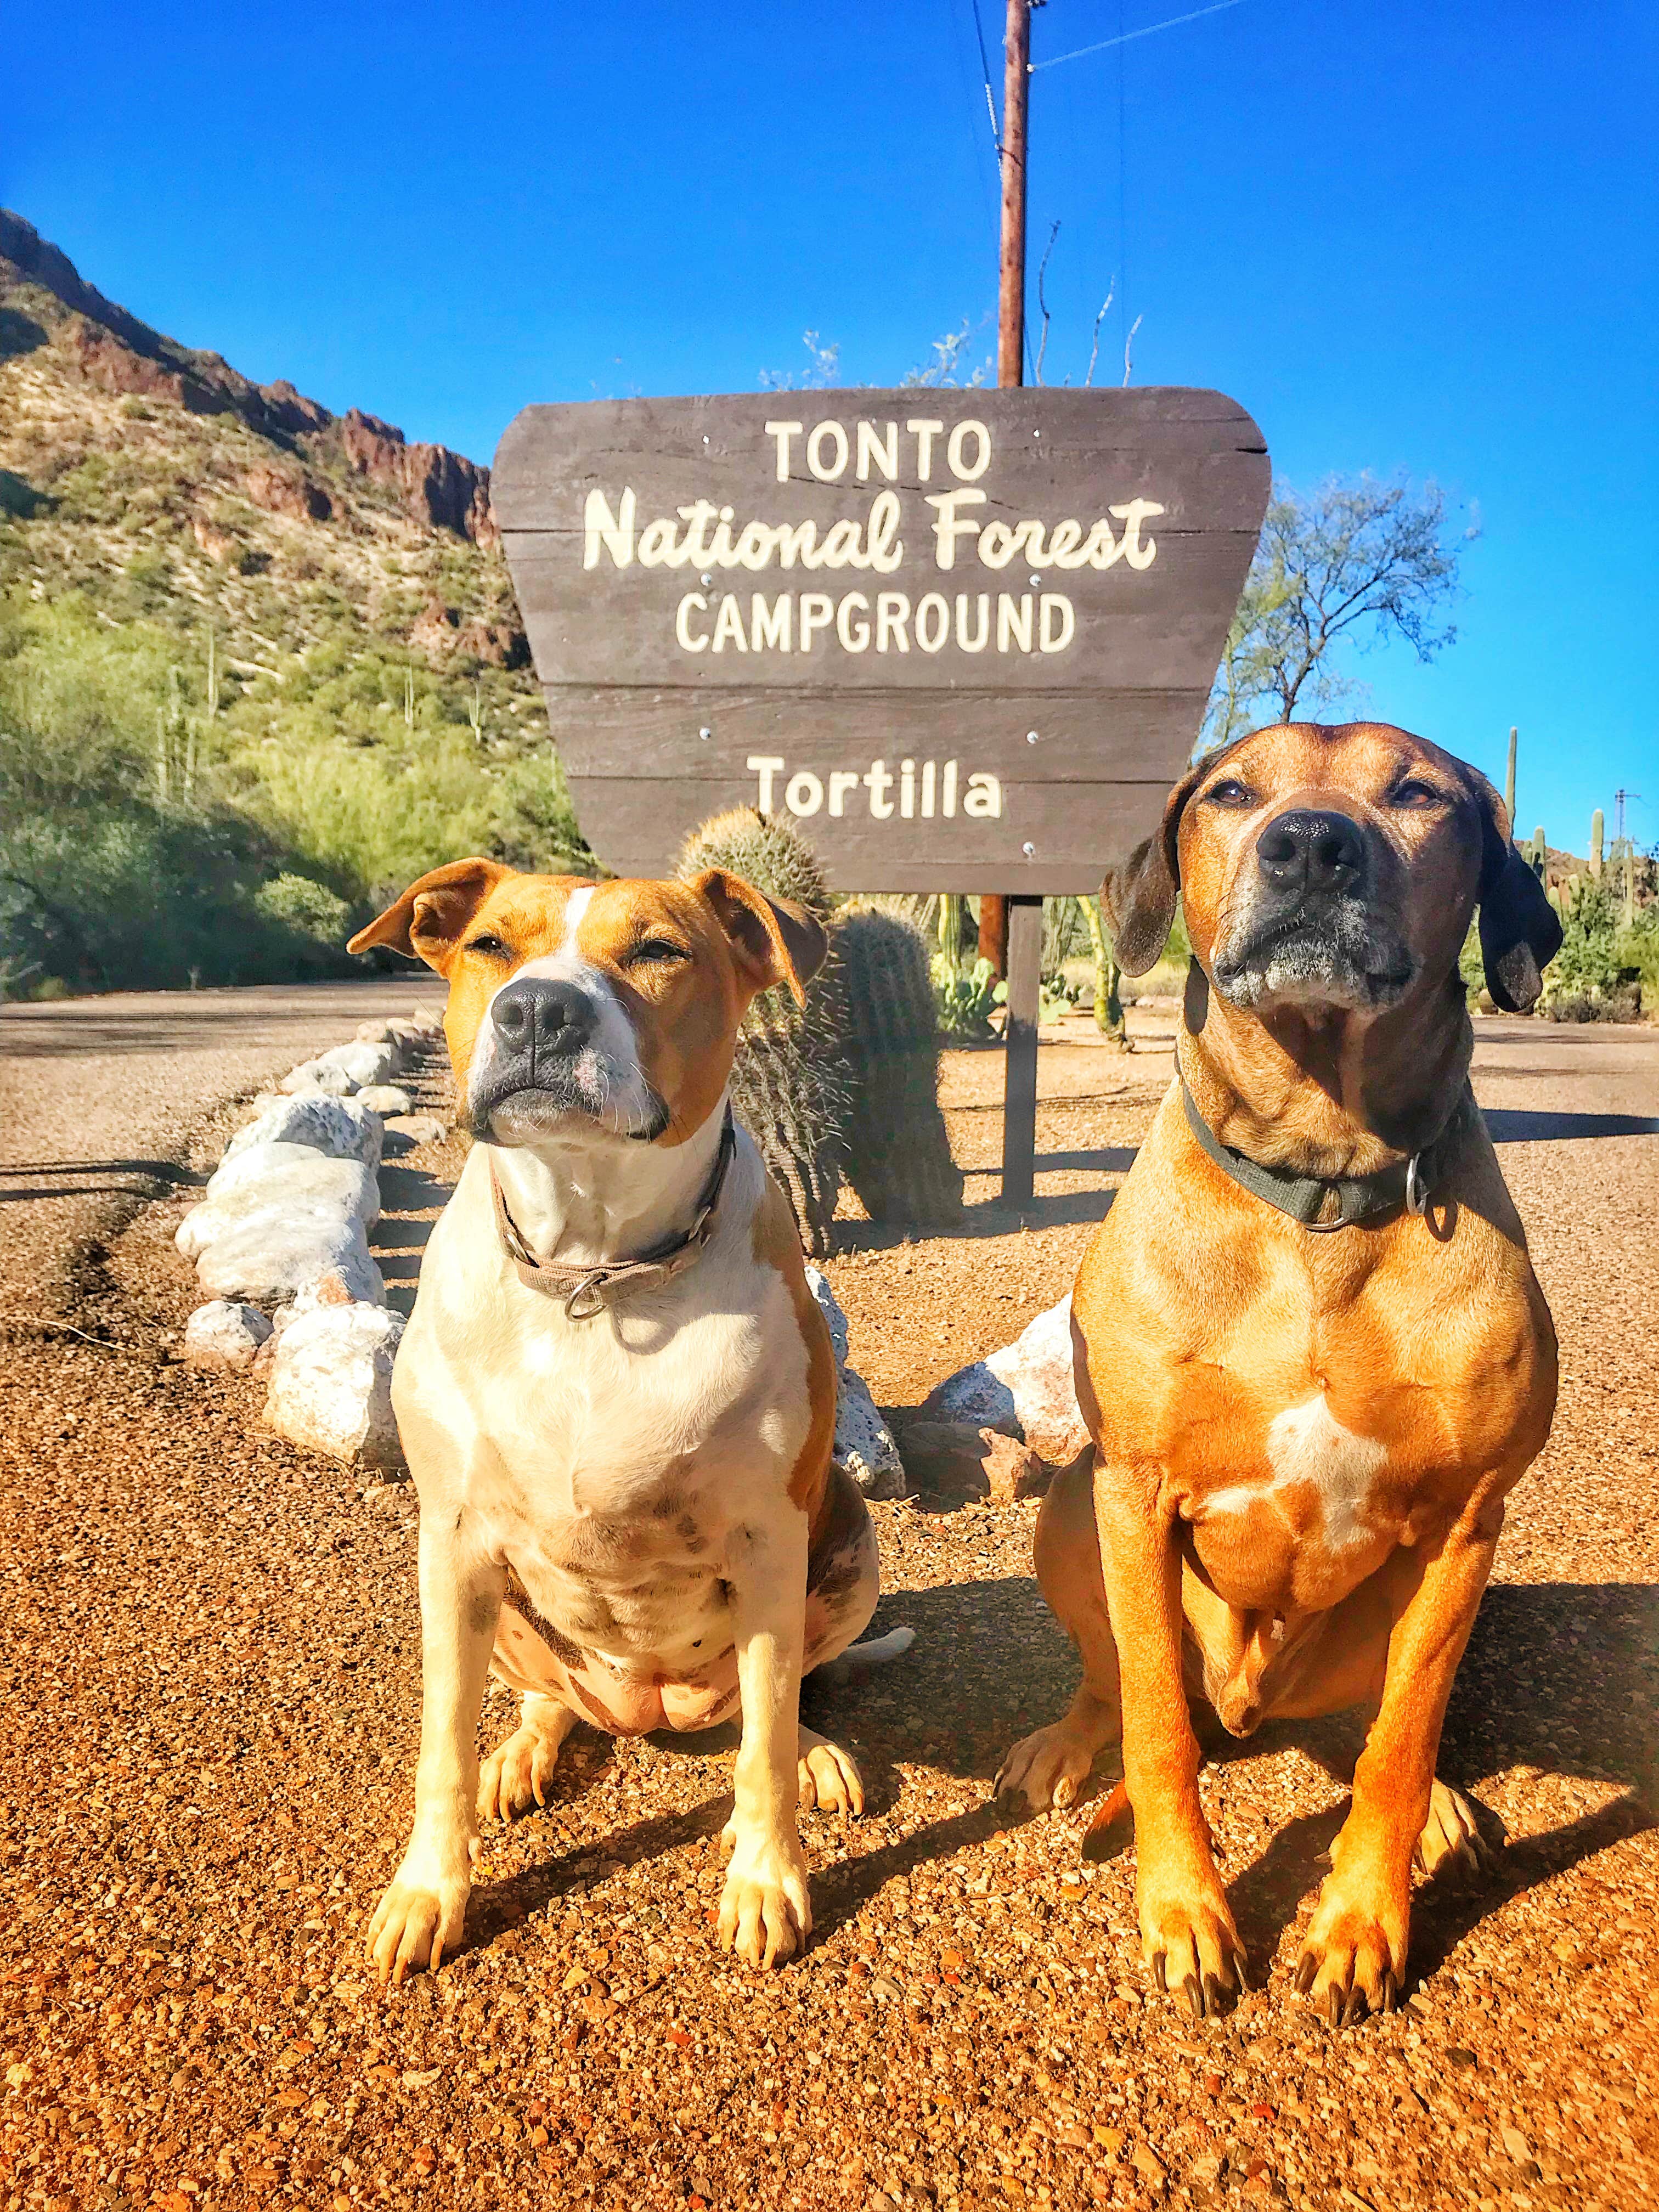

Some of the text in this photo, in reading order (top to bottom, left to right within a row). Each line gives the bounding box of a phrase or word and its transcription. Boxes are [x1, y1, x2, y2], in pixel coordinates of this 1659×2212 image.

[764, 418, 992, 483] TONTO
[582, 486, 1166, 574] National Forest
[675, 591, 1076, 654] CAMPGROUND
[746, 755, 1002, 820] Tortilla
